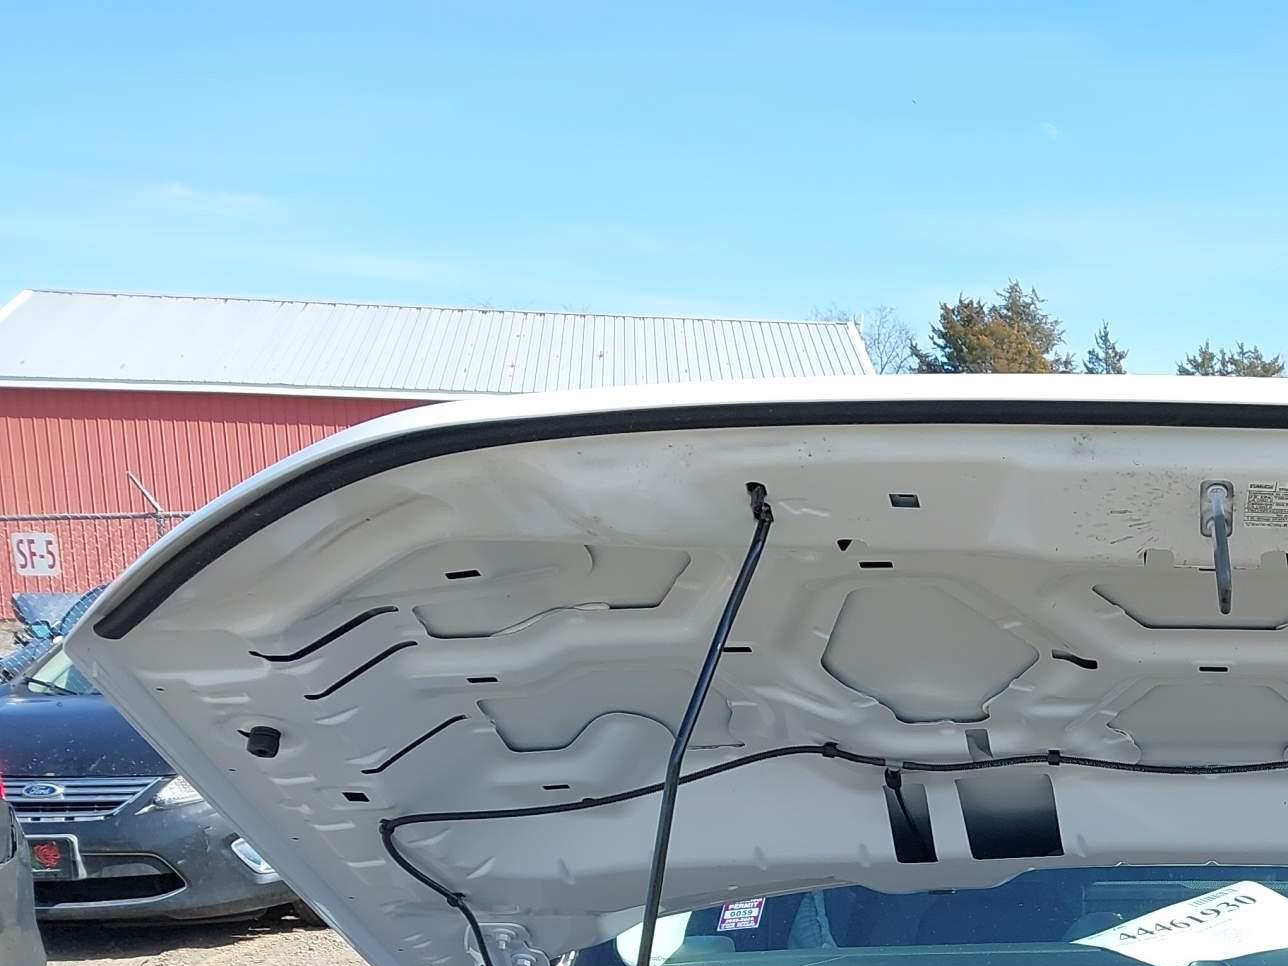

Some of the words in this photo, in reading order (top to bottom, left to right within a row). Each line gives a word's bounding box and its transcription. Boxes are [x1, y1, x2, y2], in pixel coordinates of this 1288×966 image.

[16, 539, 56, 569] SF-5
[728, 901, 759, 910] PERMIT
[730, 909, 753, 917] 0059
[1119, 895, 1256, 941] 44461930
